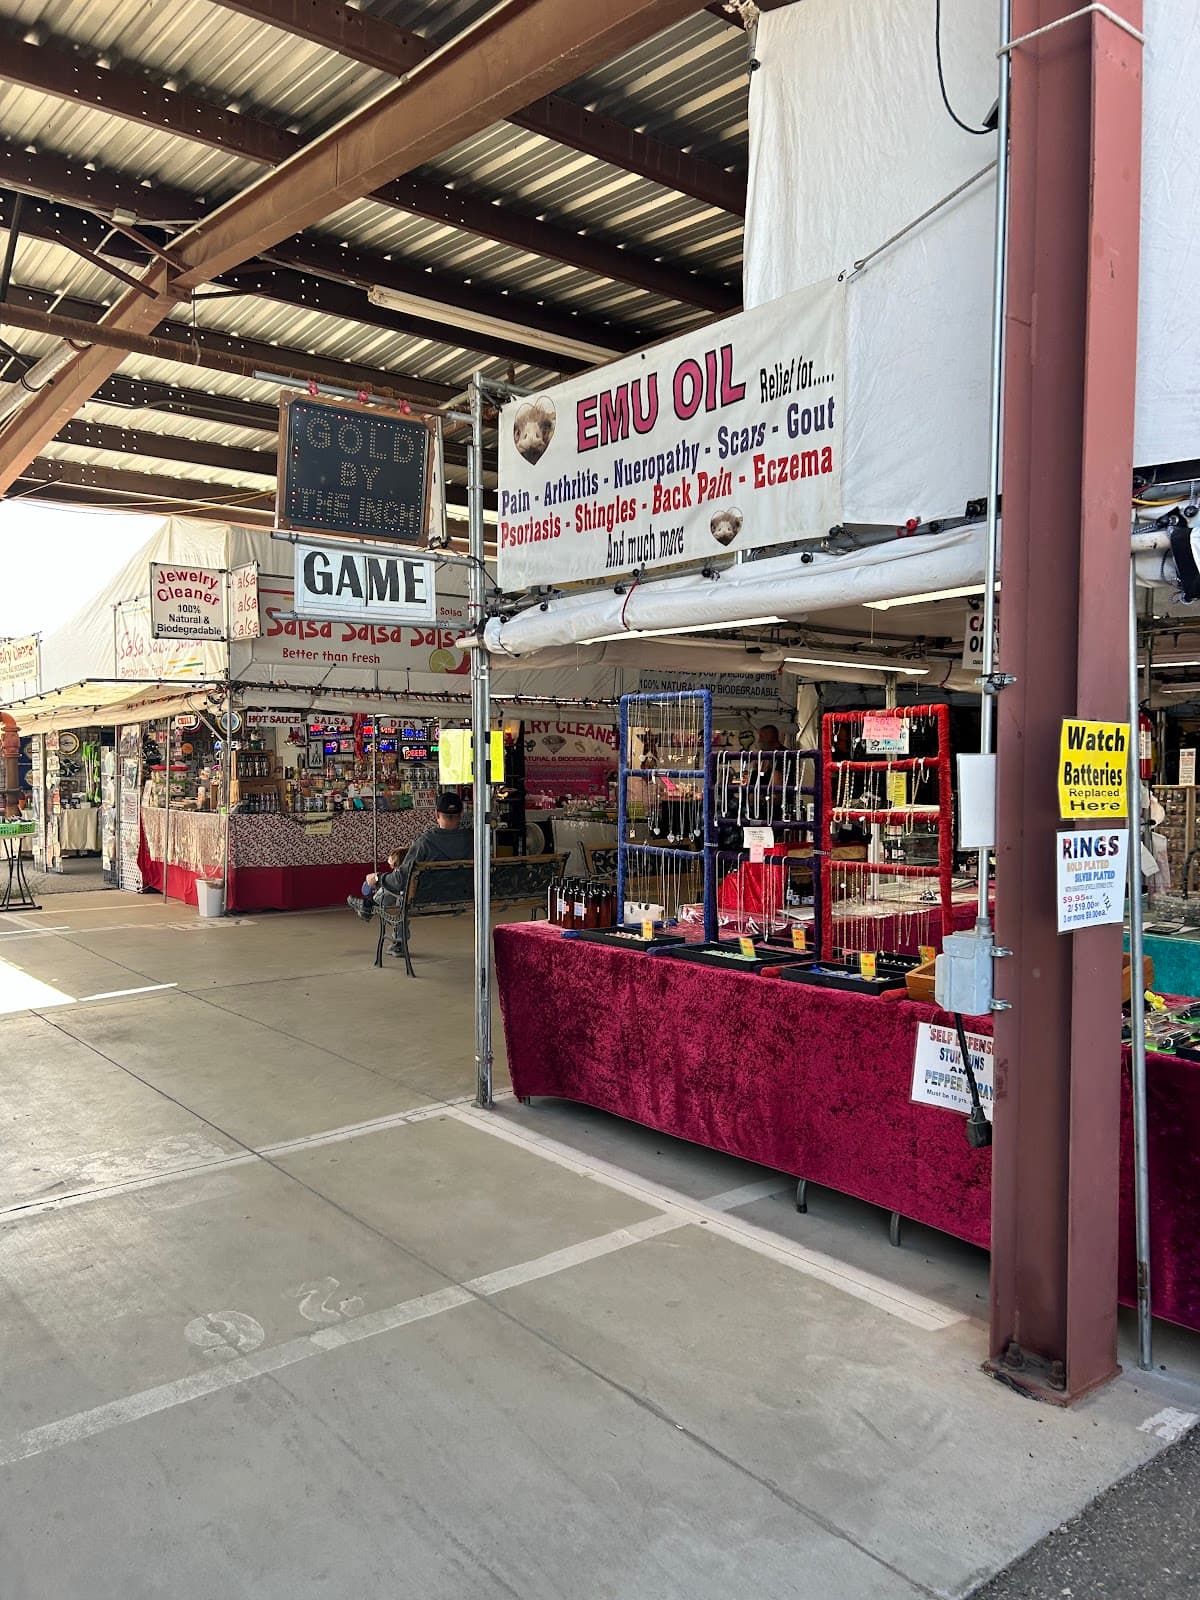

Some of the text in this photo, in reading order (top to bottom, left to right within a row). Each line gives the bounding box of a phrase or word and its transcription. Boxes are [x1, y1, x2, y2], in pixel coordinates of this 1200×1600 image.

[760, 358, 795, 404] Relief
[576, 343, 747, 453] EMU OIL
[306, 417, 415, 465] GOLD
[501, 488, 531, 517] Pain
[544, 467, 599, 507] Arthritis
[613, 438, 700, 489] Nueropathy
[717, 421, 767, 460] Scars
[786, 396, 835, 439] Gout
[340, 461, 381, 490] BY
[500, 511, 561, 549] Psoriasis
[574, 494, 637, 534] Shingles
[651, 475, 692, 516] Back
[697, 466, 732, 505] Pain
[752, 445, 833, 489] Eczema
[297, 487, 416, 528] THE INCH
[605, 523, 685, 568] And much more
[158, 570, 219, 590] Jewelry
[233, 570, 256, 589] alsa
[302, 549, 427, 604] GAME
[156, 586, 220, 606] Cleaner
[168, 613, 201, 624] Natural
[177, 604, 201, 613] 100%
[439, 606, 463, 617] Salsa
[156, 623, 222, 636] Biodegradable
[265, 606, 333, 641] Salsa
[341, 622, 401, 645] Salsa
[282, 648, 381, 664] Better than Fresh
[640, 679, 780, 697] 100% NATURAL AND BIODEGRADABLE
[248, 715, 301, 725] HOT SAUCE
[314, 716, 347, 726] SALSA
[390, 719, 415, 728] DIPS
[1067, 725, 1125, 752] Watch
[1063, 761, 1123, 787] Batteries
[1069, 788, 1120, 798] Replaced
[1070, 800, 1121, 811] Here
[1062, 835, 1120, 860] RINGS
[929, 1028, 993, 1055] SELF DFENS
[949, 1066, 967, 1075] AN
[924, 1069, 993, 1101] PEPPER SRAY
[926, 1088, 941, 1097] Must
